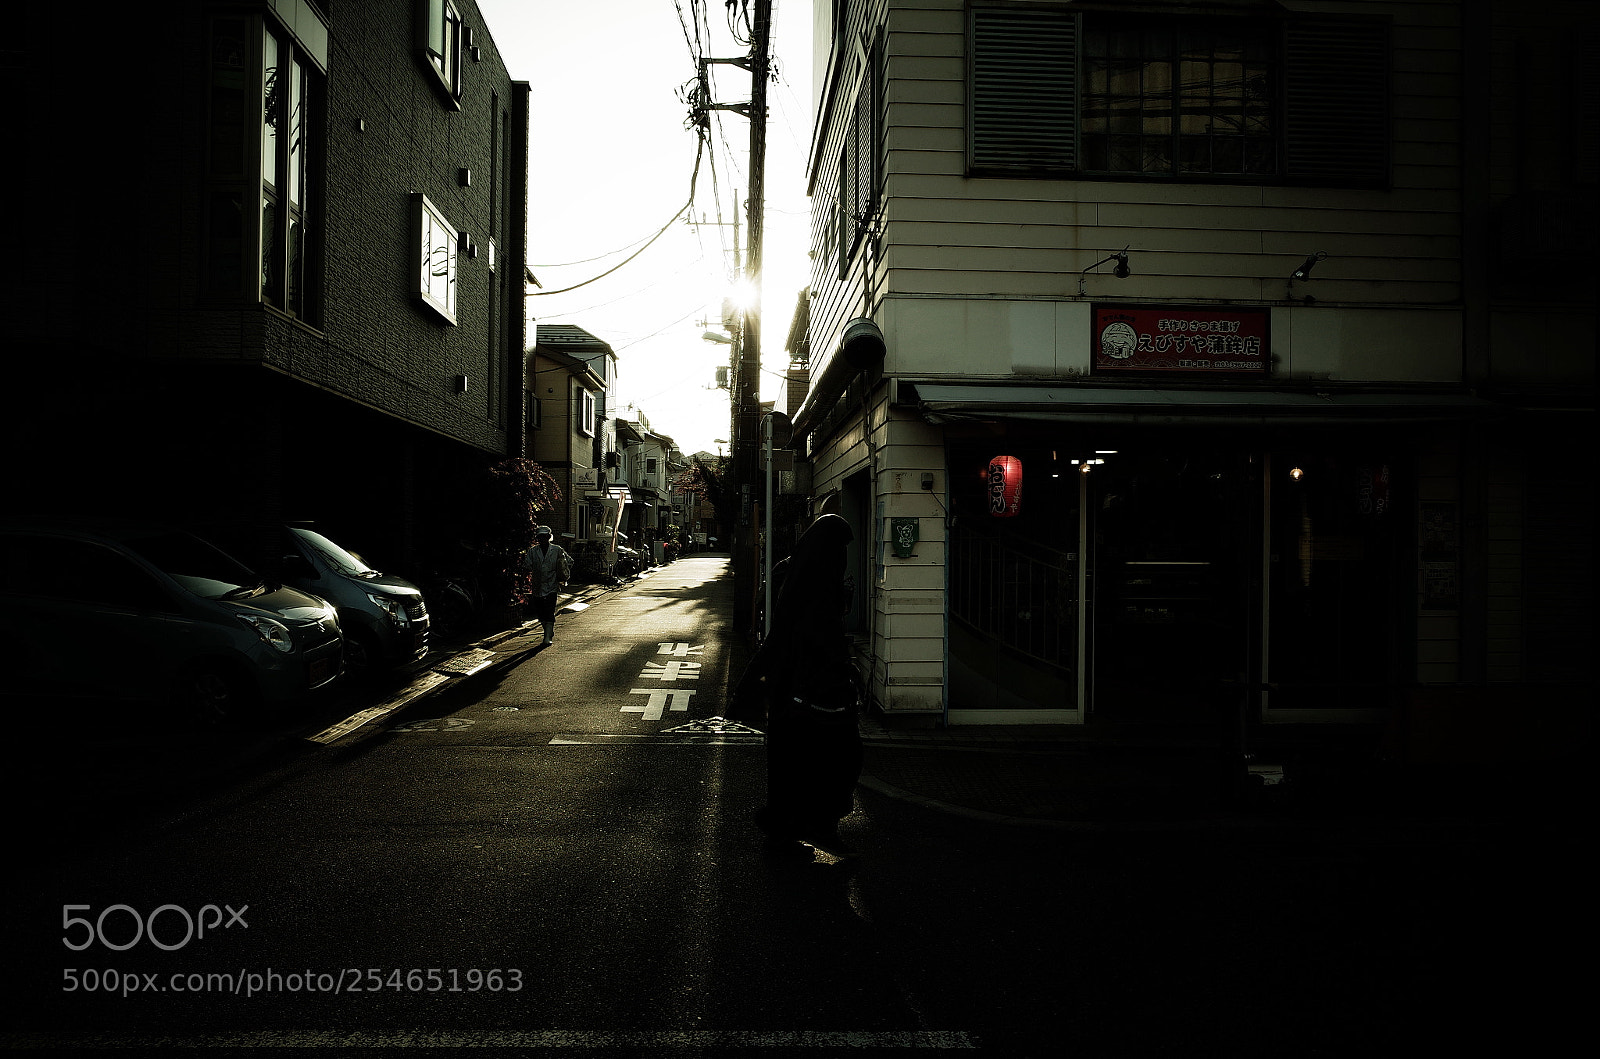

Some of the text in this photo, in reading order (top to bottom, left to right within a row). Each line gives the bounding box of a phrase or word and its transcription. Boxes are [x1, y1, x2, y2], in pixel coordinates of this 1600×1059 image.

[1158, 319, 1240, 332] 手作りさつま揚げ
[1138, 334, 1261, 355] えびすや蒲鉾店
[620, 642, 705, 721] 止まれ
